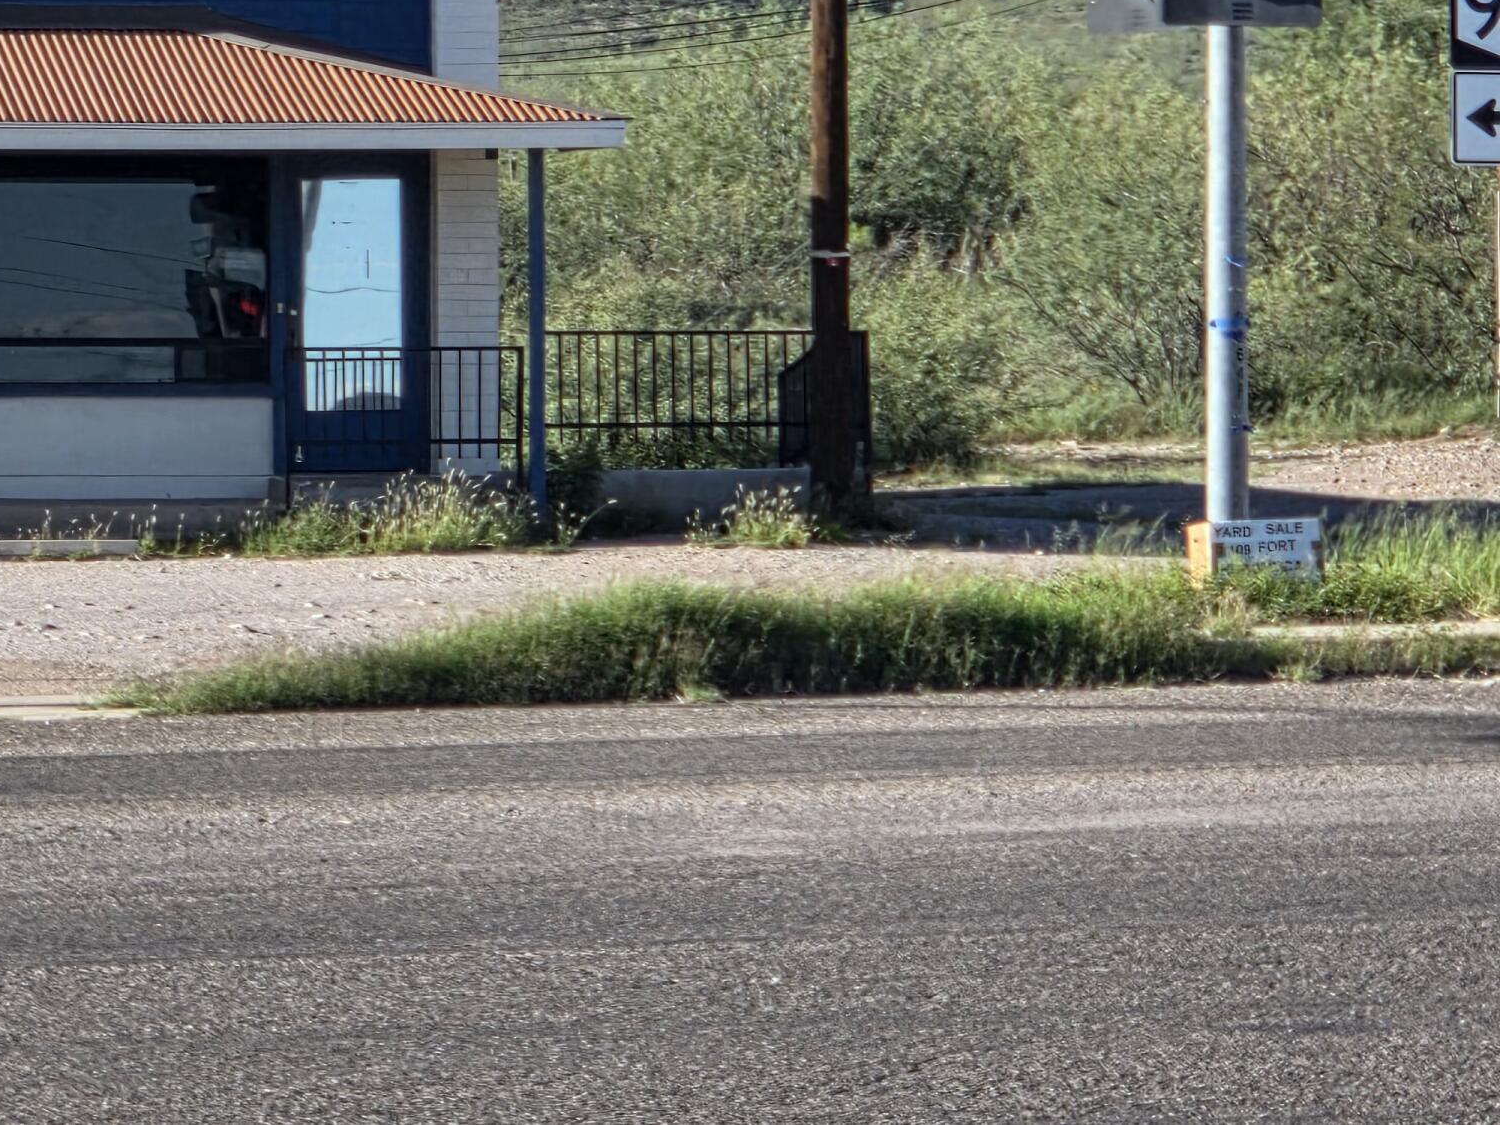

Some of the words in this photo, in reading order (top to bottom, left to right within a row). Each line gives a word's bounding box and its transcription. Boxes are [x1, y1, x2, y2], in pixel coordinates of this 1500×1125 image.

[1214, 526, 1251, 538] YARD
[1266, 522, 1303, 535] SALE
[1259, 539, 1297, 553] FORT
